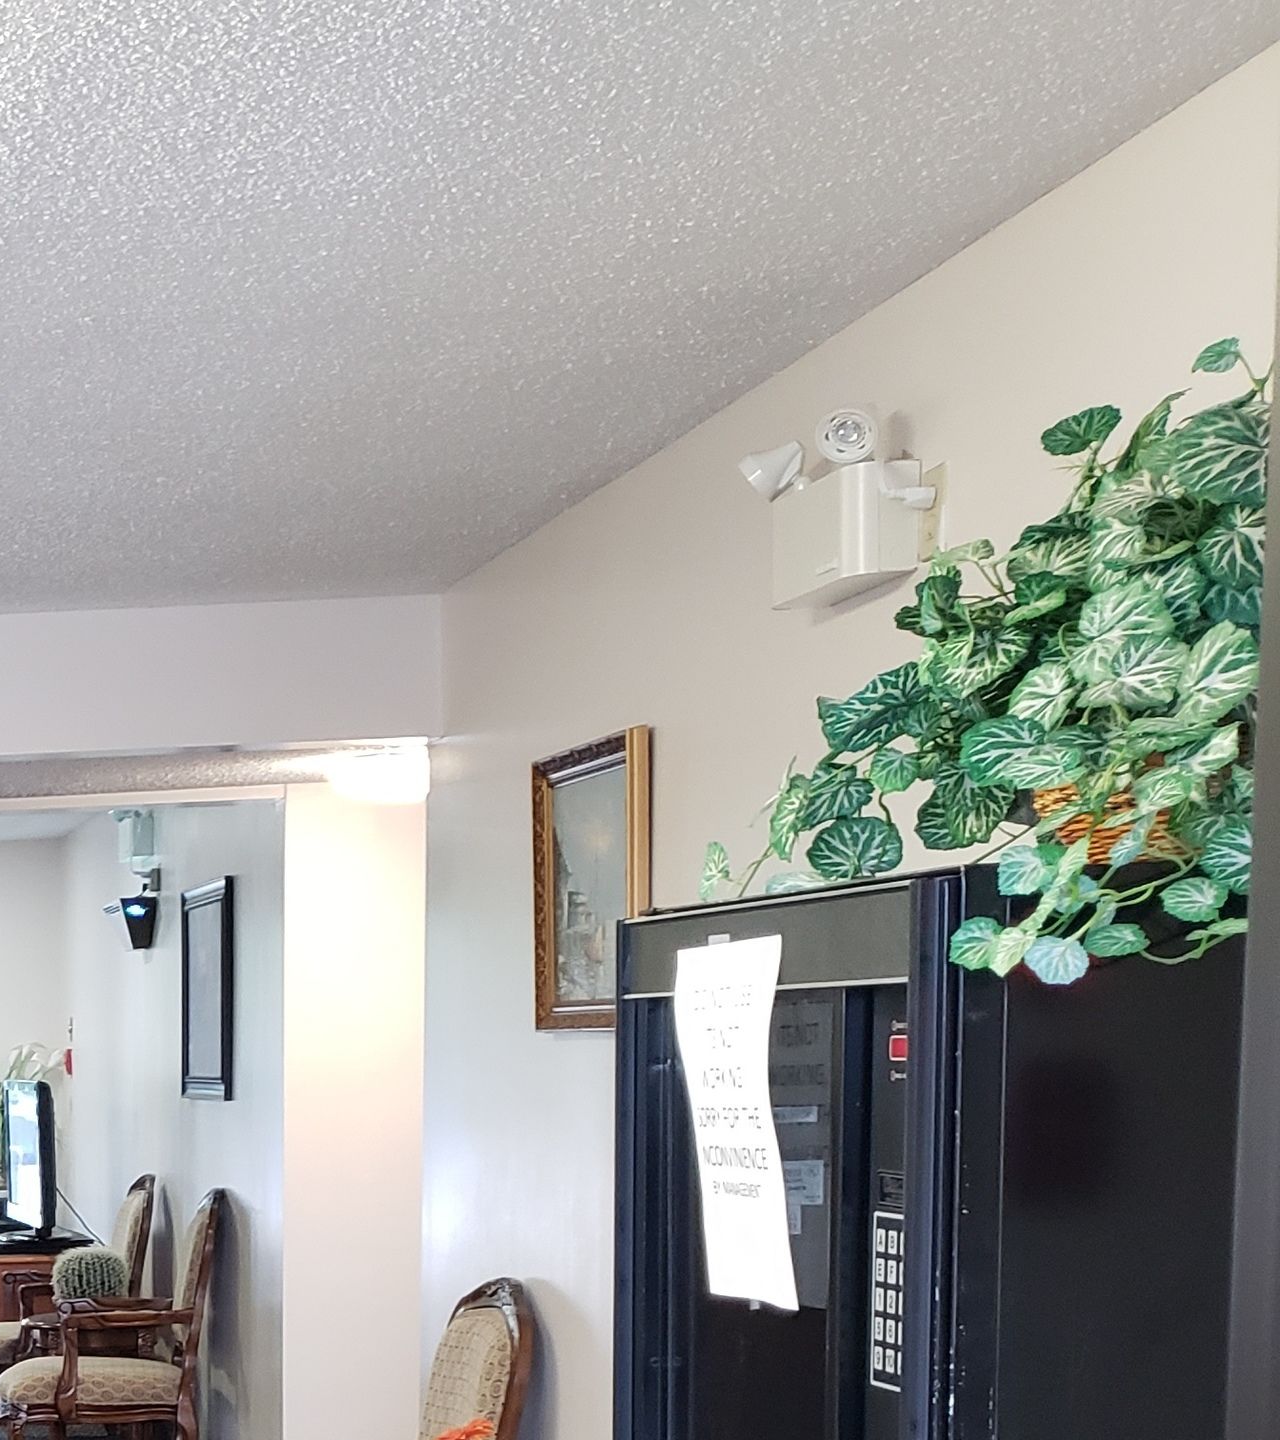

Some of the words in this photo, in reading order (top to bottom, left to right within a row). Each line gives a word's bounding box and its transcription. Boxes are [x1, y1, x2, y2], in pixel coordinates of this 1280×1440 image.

[700, 1066, 744, 1089] WORKNG
[696, 1106, 721, 1128] SORRY
[722, 1106, 740, 1129] FOR
[701, 1145, 768, 1170] NCONVINENCE
